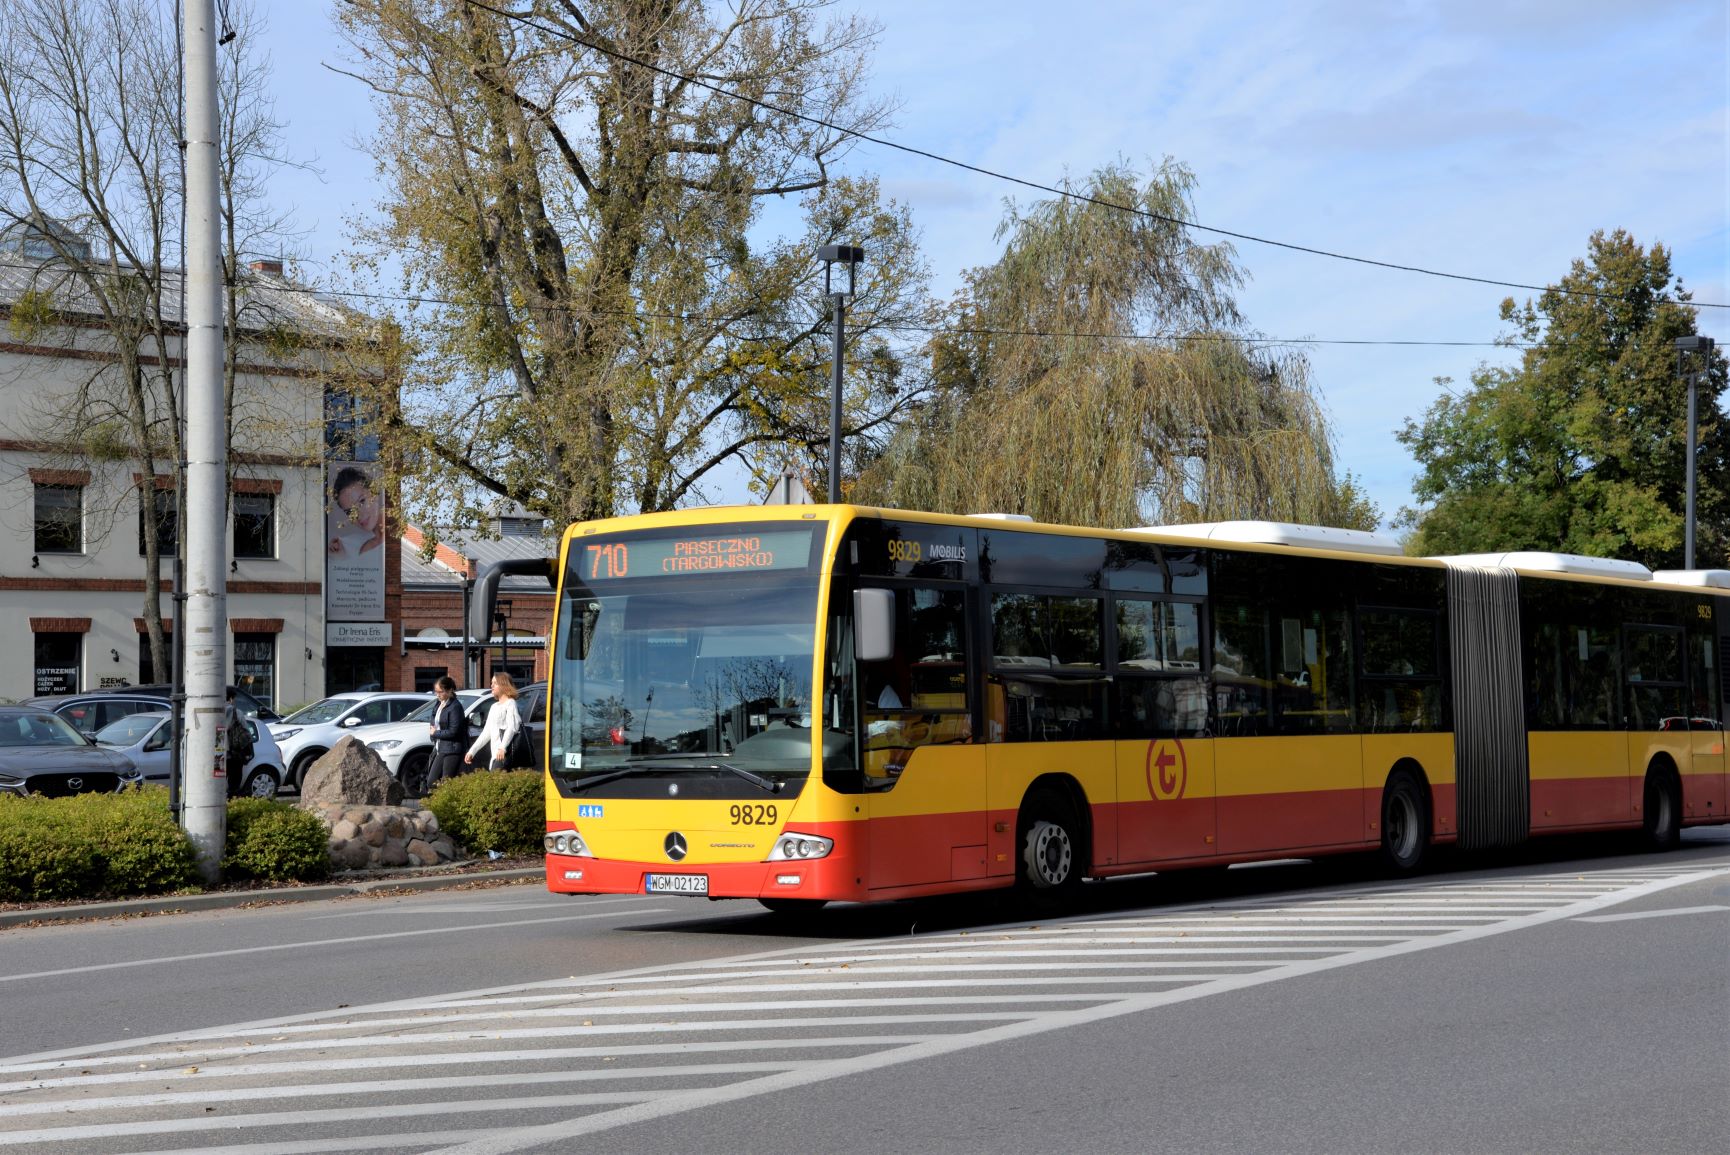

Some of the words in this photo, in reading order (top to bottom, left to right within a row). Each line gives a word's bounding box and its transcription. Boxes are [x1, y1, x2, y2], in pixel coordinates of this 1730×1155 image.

[674, 537, 760, 556] PIASECZNO
[888, 539, 921, 561] 9829
[929, 544, 966, 559] MOBILIS
[586, 543, 628, 578] 710
[662, 552, 774, 572] (TARGOWISKO)
[1697, 604, 1712, 619] 9829
[338, 627, 348, 636] Dr
[350, 627, 367, 636] Irena
[369, 627, 381, 636] Eris
[570, 754, 577, 767] 4
[729, 804, 778, 826] 9829
[651, 876, 671, 890] WGM
[674, 877, 707, 891] 02123
